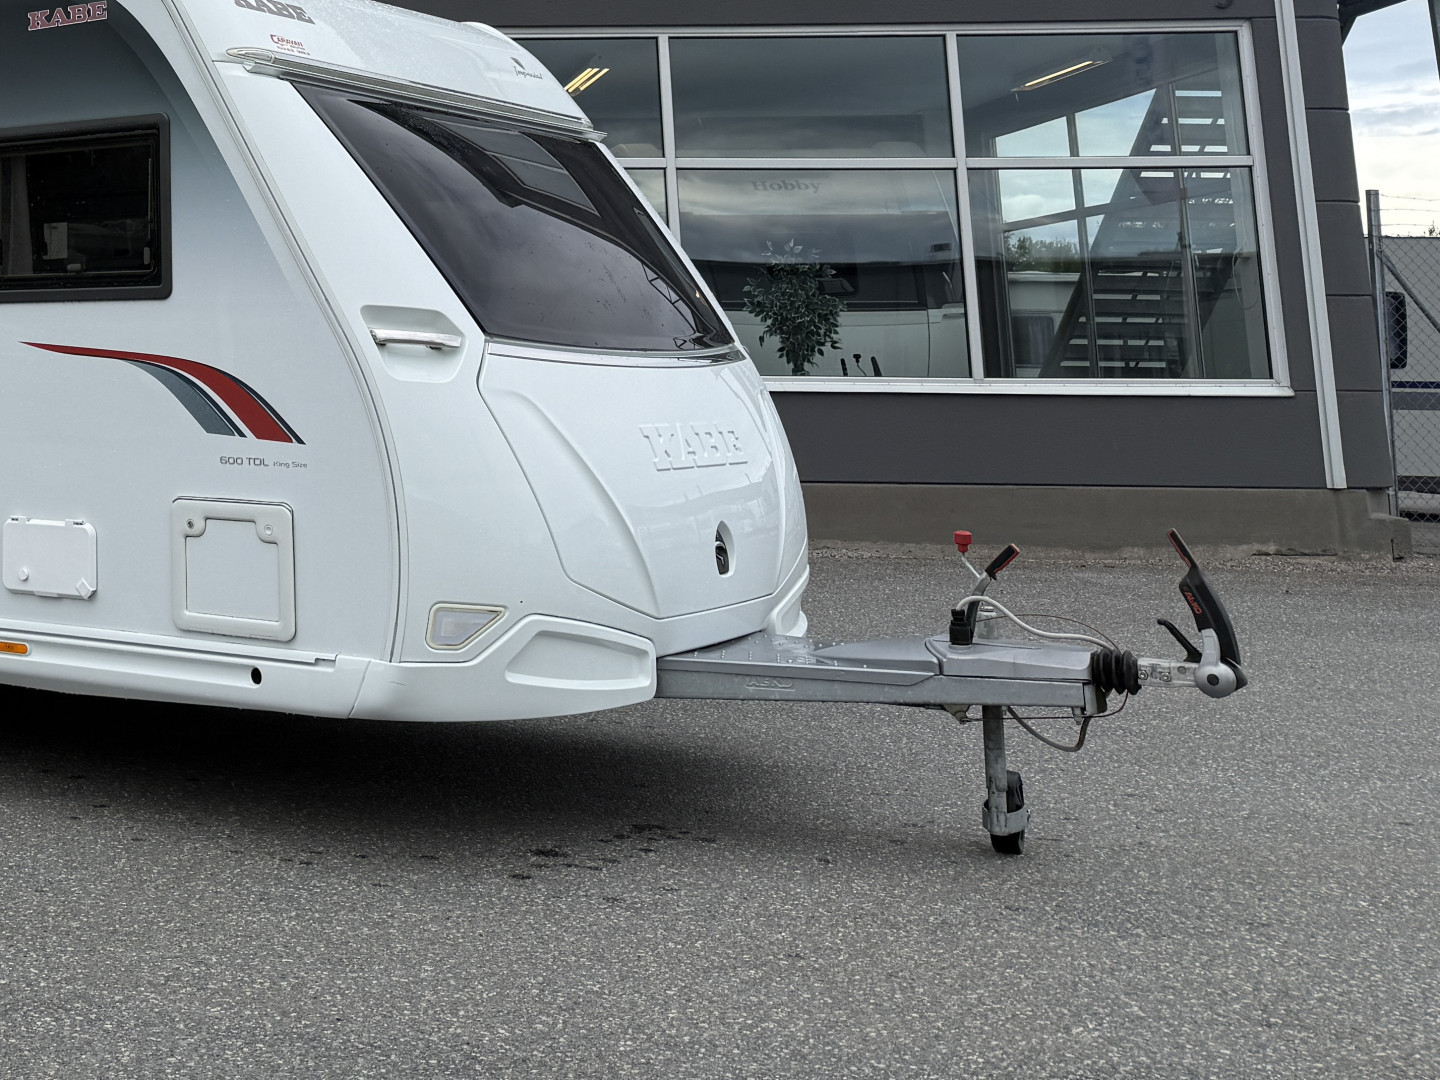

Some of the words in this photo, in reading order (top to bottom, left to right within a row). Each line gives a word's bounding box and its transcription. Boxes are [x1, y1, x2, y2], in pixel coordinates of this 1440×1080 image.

[27, 0, 108, 31] KABE
[751, 180, 821, 194] Hobby
[639, 421, 748, 471] KABE
[220, 455, 244, 466] 600
[246, 457, 269, 467] TDL
[273, 461, 290, 469] King
[291, 461, 308, 469] Size
